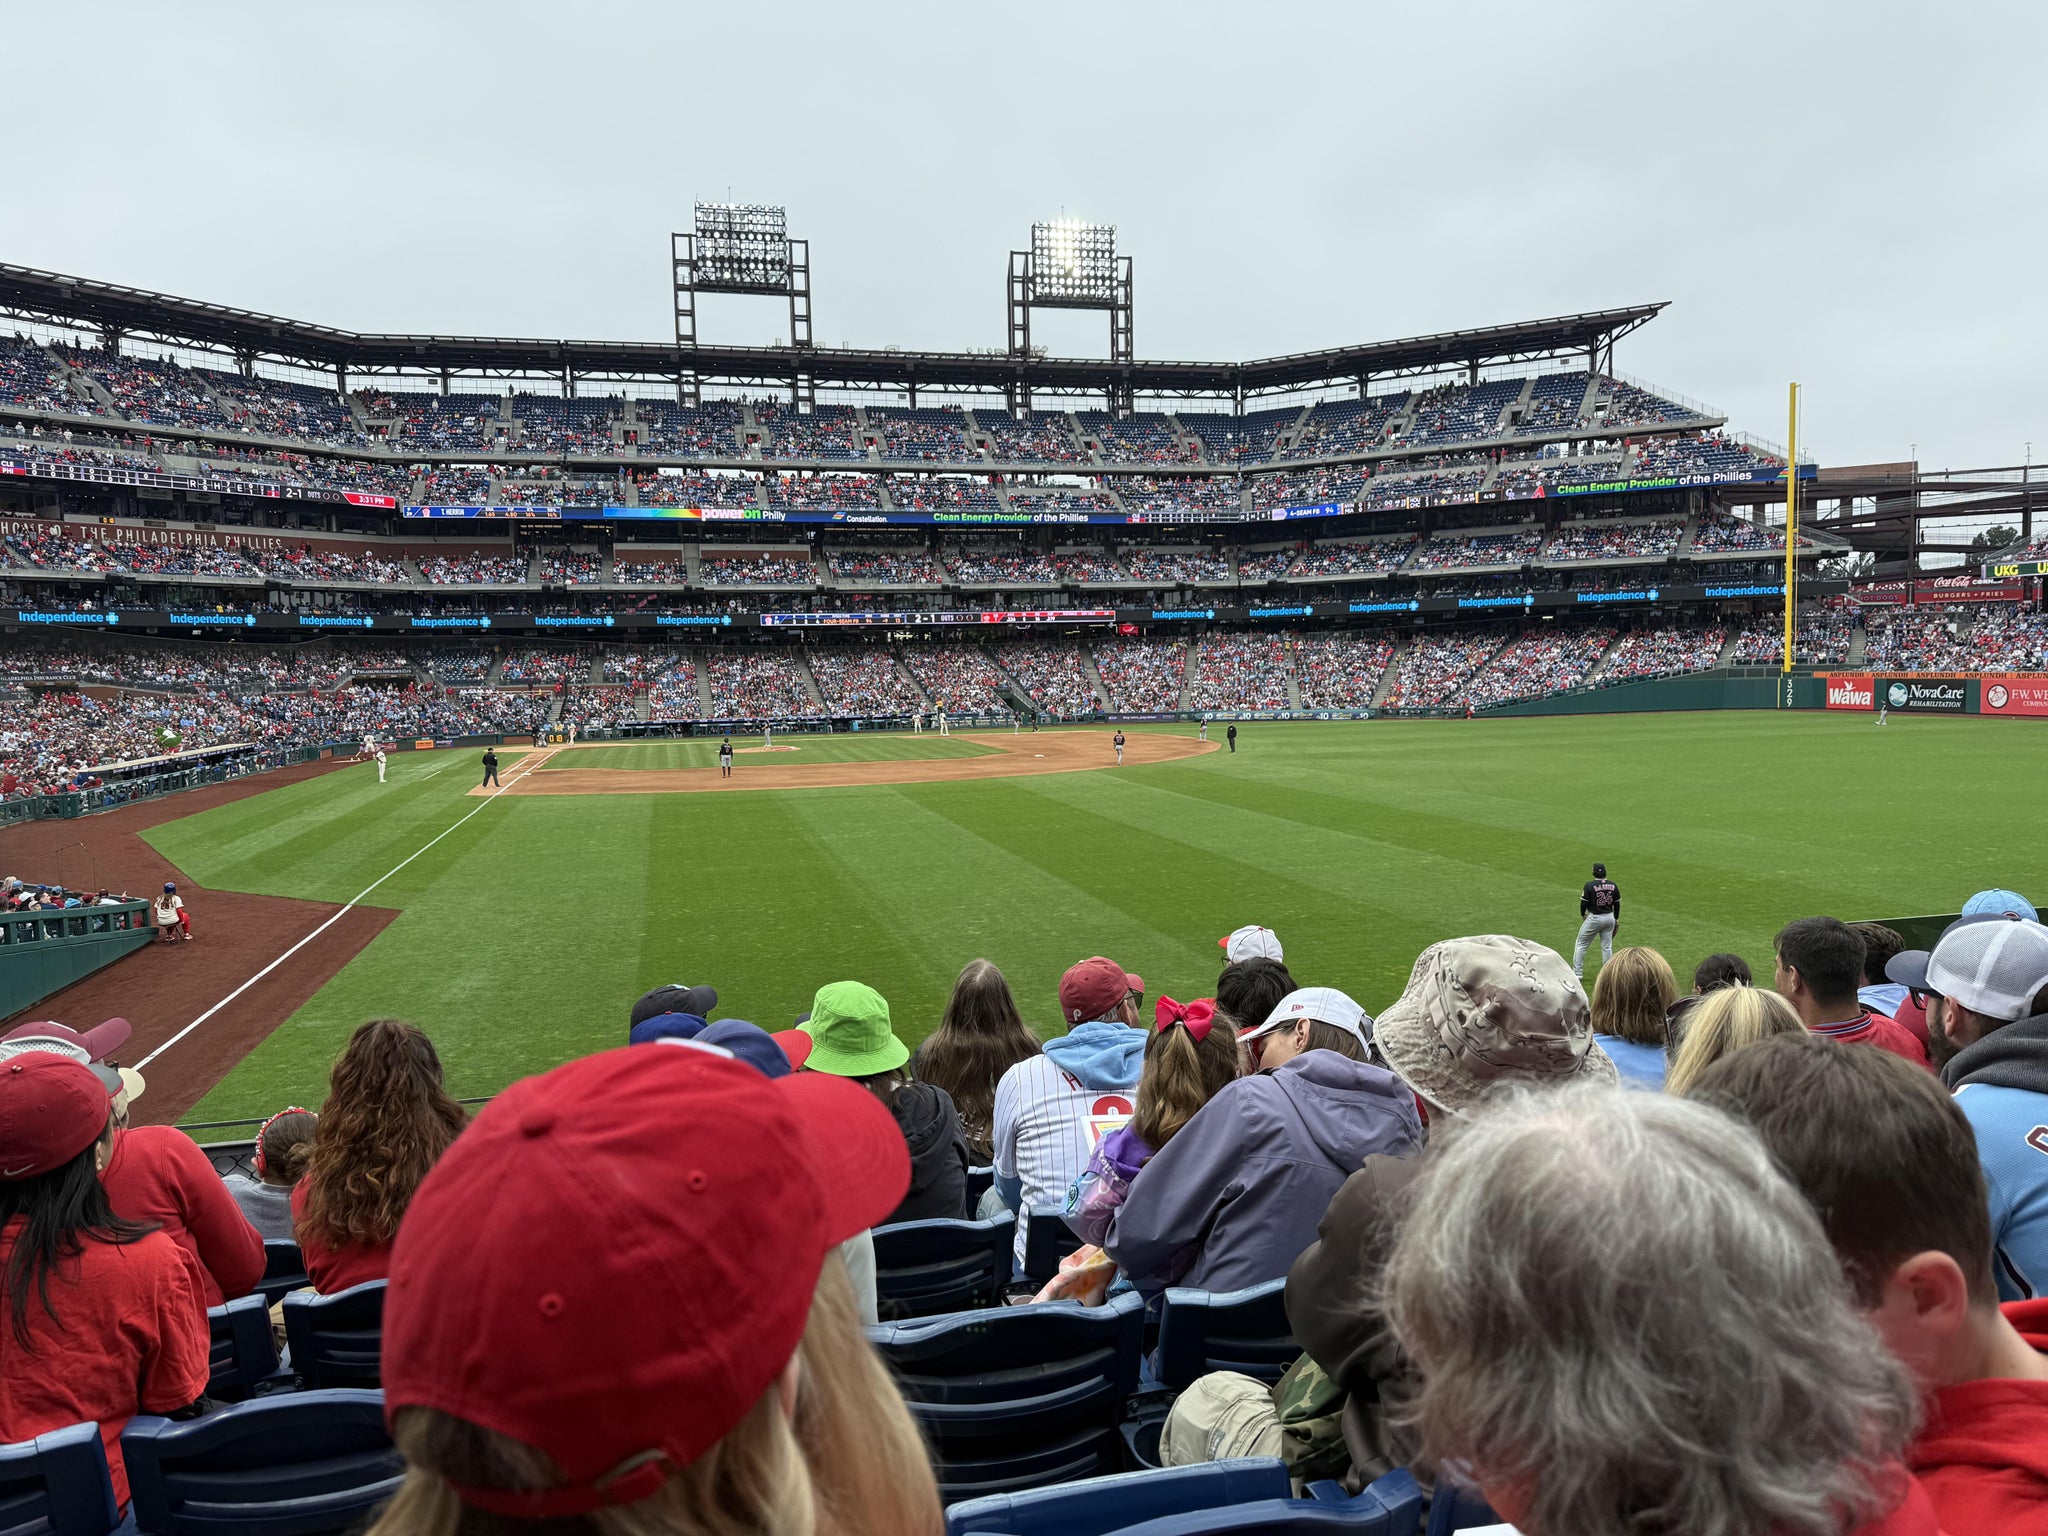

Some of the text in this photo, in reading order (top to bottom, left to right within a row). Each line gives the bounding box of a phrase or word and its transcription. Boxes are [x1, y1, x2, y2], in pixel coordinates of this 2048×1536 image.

[190, 480, 196, 488] R
[214, 482, 220, 490] H
[237, 484, 243, 492] E
[1557, 471, 1752, 494] Clean Energy Provider of the Phillies
[286, 488, 321, 499] 2-1 OUTS
[374, 497, 385, 505] PM
[762, 511, 786, 522] Philly
[846, 515, 887, 523] Constellation
[933, 513, 1089, 523] Clean Energy Provider of the Phillies
[80, 526, 107, 540] THE
[116, 528, 217, 546] PHILADELPHIA
[225, 535, 282, 549] PHILLIES
[1994, 565, 2019, 577] UKG
[1577, 591, 1645, 602] Independence
[1705, 585, 1779, 597] Independence
[1349, 602, 1407, 612] Independence
[1458, 596, 1522, 607] Independence
[19, 611, 104, 624] Independence
[1152, 610, 1205, 620] Independence
[1250, 607, 1303, 617] Independence
[170, 614, 243, 625] Independence
[300, 616, 362, 627] Independence
[411, 617, 478, 628] Independence
[535, 616, 602, 627] Independence
[657, 615, 720, 626] Independence
[940, 614, 954, 622] OUTS
[1829, 688, 1872, 706] Wawa
[1908, 684, 1964, 699] NovaCare
[2012, 689, 2030, 700] F.W.
[1909, 700, 1961, 708] REHABILITATION
[1204, 712, 1213, 720] 10
[1243, 712, 1251, 720] 10
[1281, 712, 1290, 720] 10
[1320, 712, 1329, 720] 10
[1360, 712, 1369, 720] 10
[1596, 891, 1613, 906] 24
